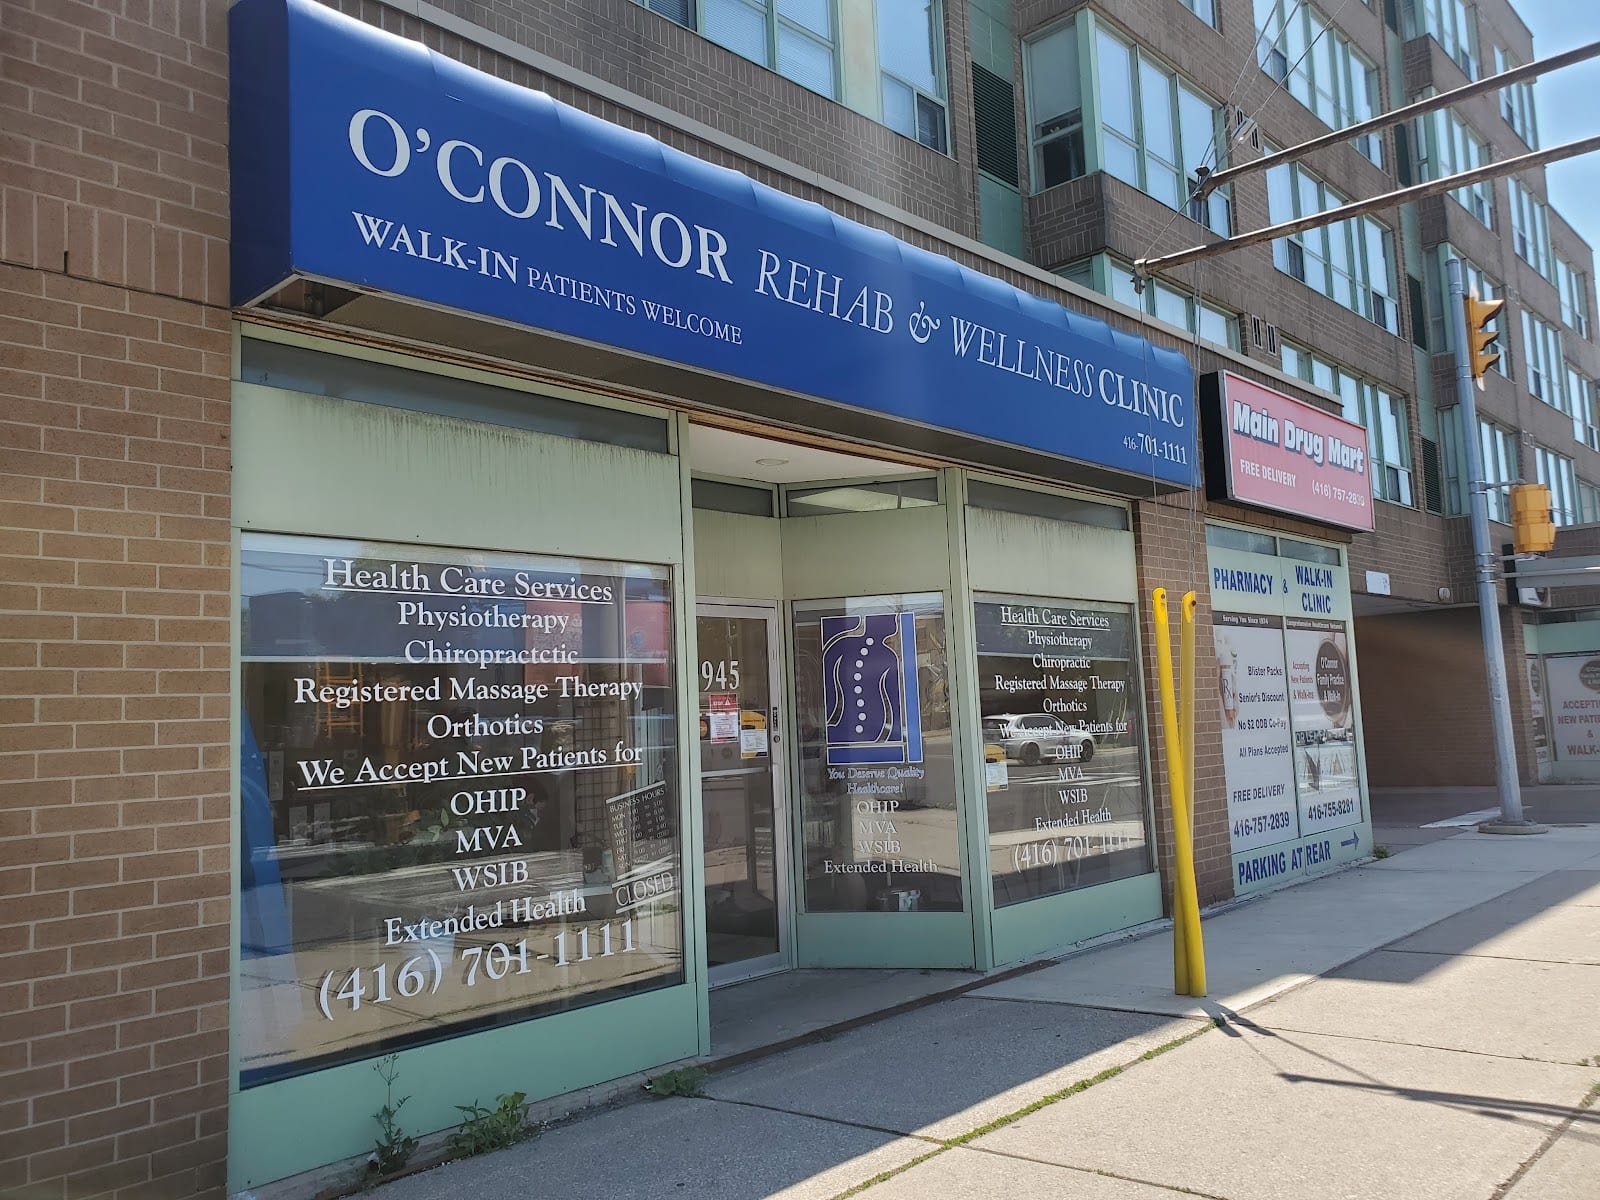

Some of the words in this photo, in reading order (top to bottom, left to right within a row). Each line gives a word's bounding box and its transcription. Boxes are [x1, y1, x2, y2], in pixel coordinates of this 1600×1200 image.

[348, 108, 733, 285] O'CONNOR
[754, 249, 894, 335] REHAB
[908, 301, 940, 344] &
[950, 315, 1095, 399] WELLNESS
[1099, 368, 1185, 428] CLINIC
[352, 211, 518, 284] WALK-IN
[527, 267, 636, 316] PATIENTS
[642, 300, 743, 345] WELCOME
[1123, 432, 1187, 464] 416-701-1111
[1233, 400, 1280, 446] Main
[1284, 418, 1325, 466] Drug
[1328, 435, 1364, 475] Mart
[1240, 459, 1260, 477] FREE
[1262, 465, 1296, 487] DELIVERY
[1312, 480, 1331, 500] (416)
[323, 559, 430, 590] Health
[440, 567, 505, 595] Care
[515, 572, 612, 601] Services
[1213, 568, 1272, 595] PHARMACY
[1283, 579, 1288, 593] &
[1295, 565, 1332, 588] WALK-IN
[1302, 592, 1331, 613] CLINIC
[398, 602, 569, 632] Physiotherapy
[1001, 606, 1039, 625] Health
[1042, 609, 1067, 626] Care
[1070, 611, 1109, 627] Services
[1028, 631, 1092, 649] Physiotherapy
[1033, 653, 1091, 671] Chiropractic
[1248, 665, 1265, 676] Blister
[1267, 665, 1282, 676] Packs
[701, 661, 739, 691] 945
[995, 675, 1046, 693] Registered
[1050, 675, 1087, 692] Massage
[1090, 676, 1125, 692] Therapy
[294, 678, 440, 707] Registered
[449, 677, 548, 703] Massage
[555, 676, 642, 701] Therapy
[1239, 692, 1261, 702] Senior's
[1262, 692, 1284, 702] Discount
[1043, 698, 1087, 712] Orthotics
[427, 714, 543, 739] Orthotics
[1079, 719, 1113, 733] Patients
[1116, 719, 1127, 731] for
[1238, 721, 1246, 730] No
[1248, 719, 1255, 730] $2
[1256, 719, 1268, 729] ODB
[1269, 718, 1286, 730] Co-Pay
[1558, 716, 1576, 724] NEW
[1056, 744, 1083, 759] OHIP
[1248, 747, 1263, 757] Plans
[1264, 744, 1289, 757] Accepted
[298, 760, 344, 785] We
[355, 757, 447, 783] Accept
[457, 751, 513, 775] New
[520, 744, 607, 770] Patients
[614, 741, 642, 763] for
[827, 768, 845, 779] You
[848, 768, 885, 778] Deserve
[888, 766, 924, 779] Quality
[1058, 767, 1083, 781] MVA
[450, 788, 526, 816] OHIP
[610, 797, 640, 812] BUSINESS
[642, 788, 664, 801] HOURS
[1058, 788, 1088, 805] WSIB
[1233, 790, 1250, 803] FREE
[1253, 783, 1285, 800] DELIVERY
[857, 801, 899, 813] OHIP
[859, 821, 897, 833] MVA
[1035, 813, 1078, 832] Extended
[1081, 808, 1112, 825] Health
[1234, 811, 1289, 838] 416-757-2839
[456, 824, 522, 854] MVA
[859, 840, 901, 853] WSIB
[824, 860, 886, 873] Extended
[891, 860, 938, 873] Health
[1014, 840, 1057, 873] (416)
[1238, 851, 1286, 885] PARKING
[1292, 848, 1302, 870] AT
[1306, 840, 1331, 866] REAR
[452, 861, 529, 891] WSIB
[616, 872, 672, 906] CLOSED
[384, 901, 502, 946] Extended
[510, 889, 586, 922] Health
[319, 948, 442, 1021] (416)
[461, 919, 635, 987] 701-1111
